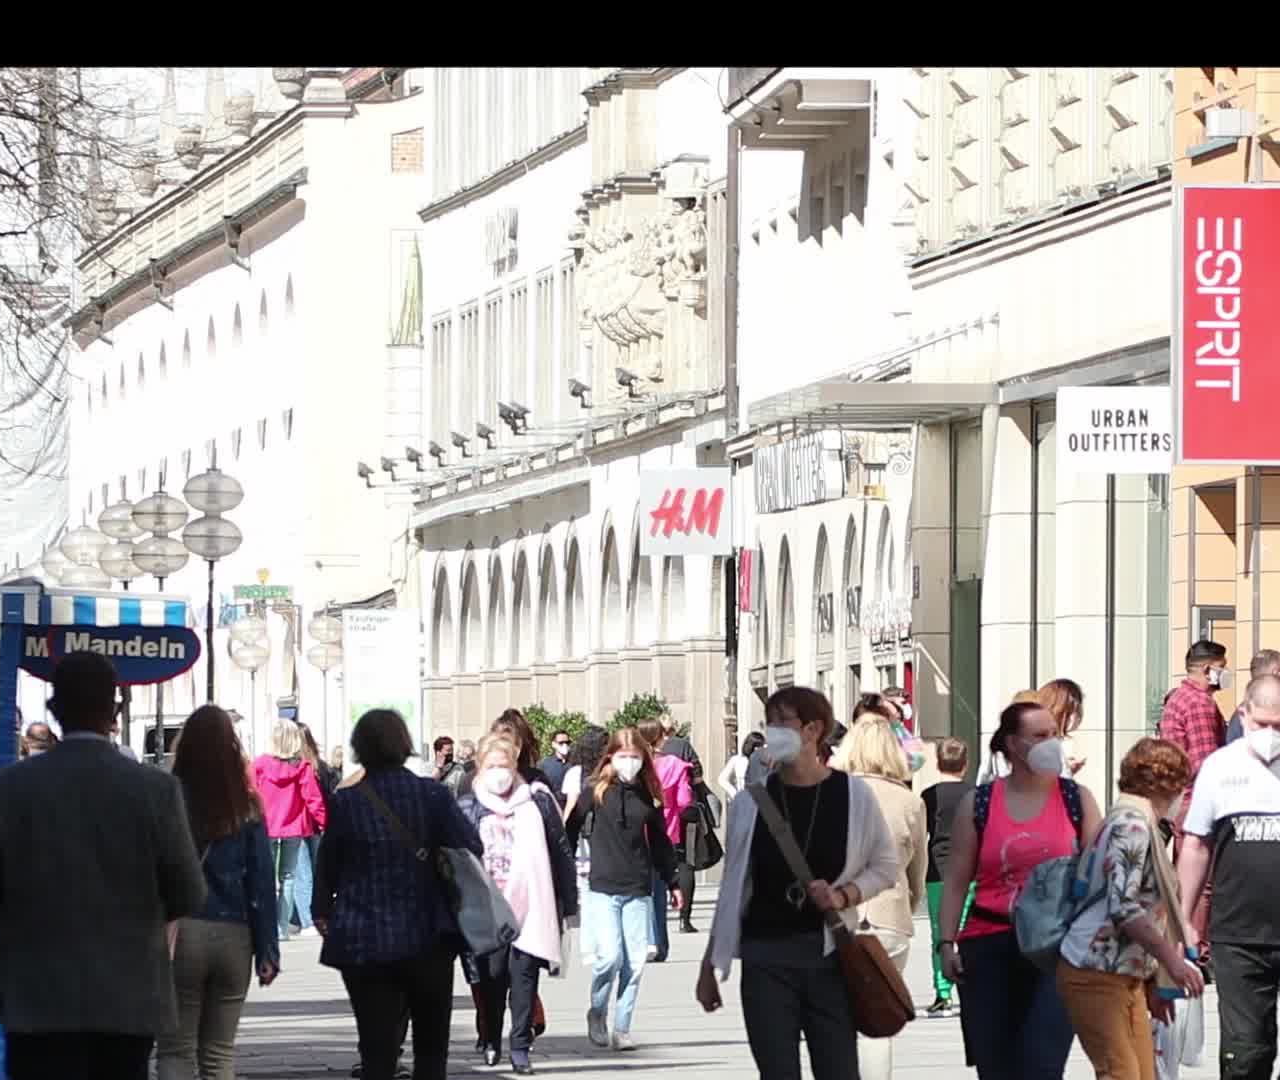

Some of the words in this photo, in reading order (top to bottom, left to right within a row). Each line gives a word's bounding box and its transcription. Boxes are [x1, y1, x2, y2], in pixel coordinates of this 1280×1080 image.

[1194, 217, 1242, 402] ESPRIT
[1091, 409, 1148, 428] URBAN
[1068, 433, 1172, 452] OUTFITTERS
[650, 487, 724, 538] H&M
[64, 631, 185, 659] Mandeln
